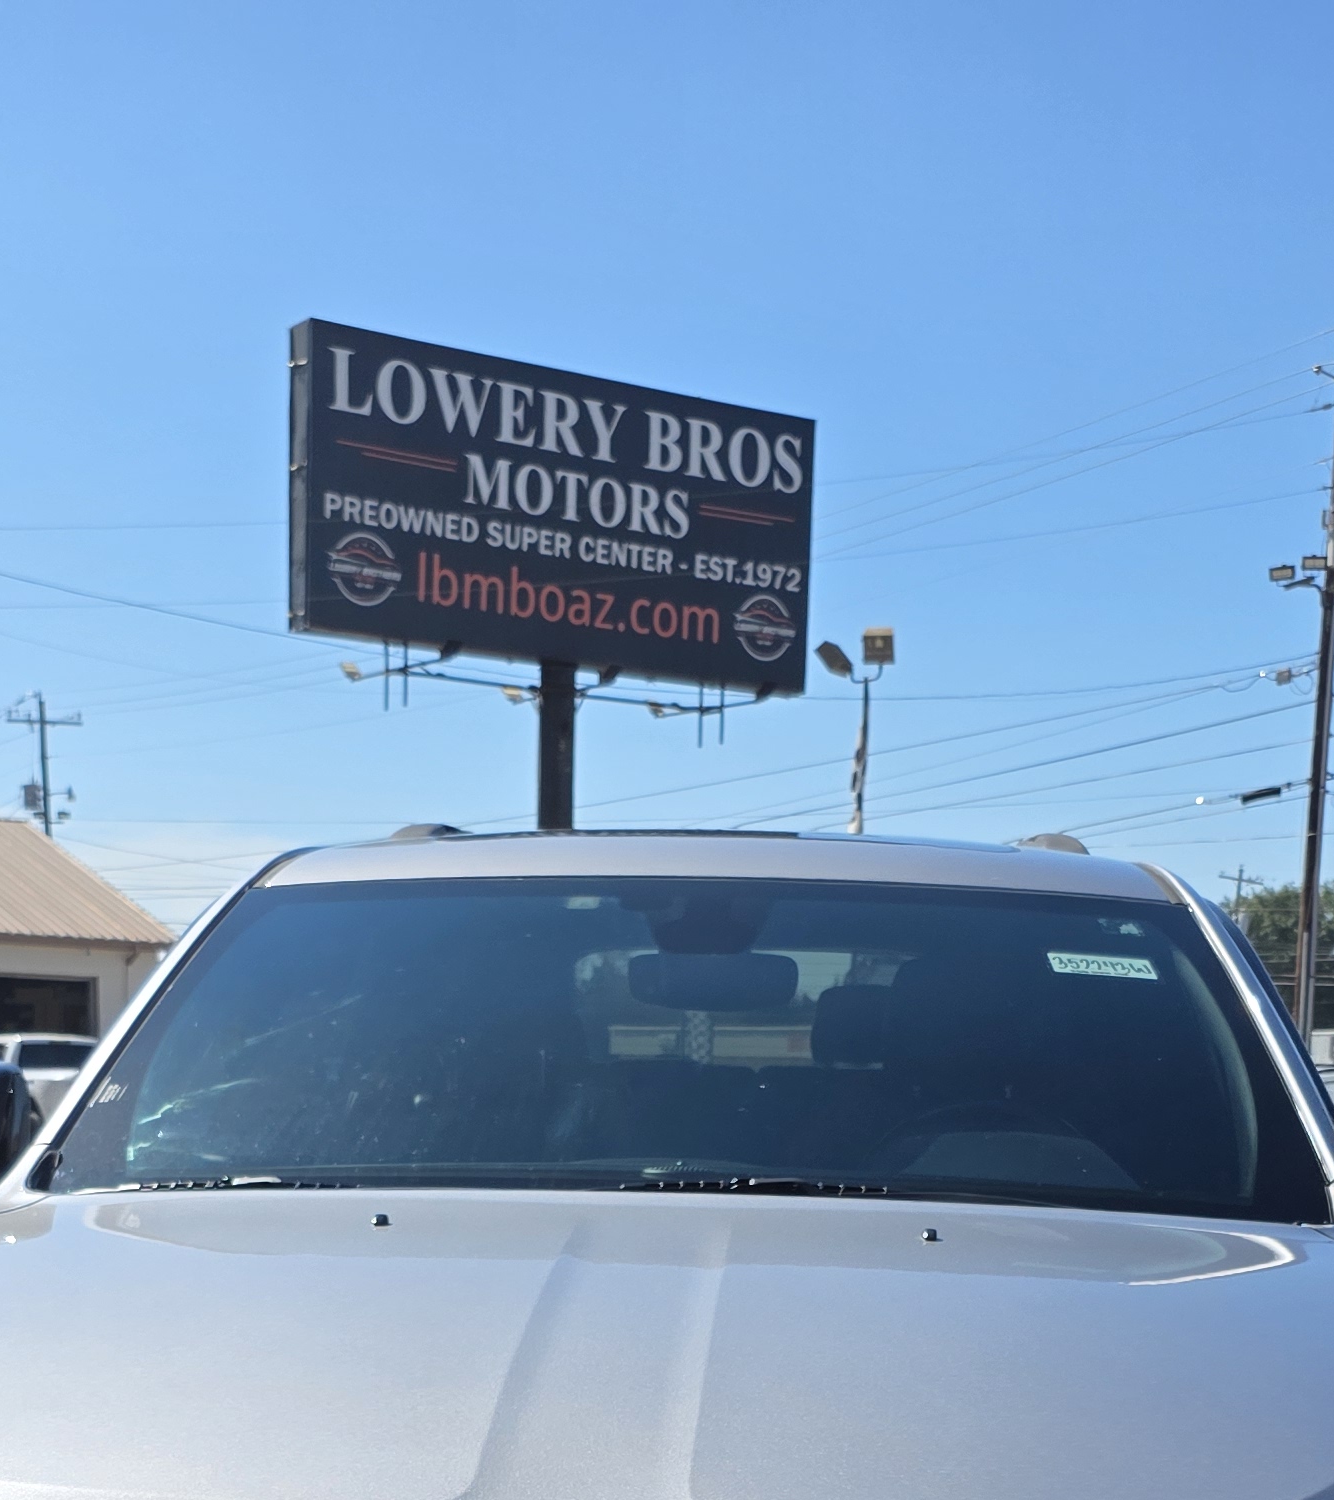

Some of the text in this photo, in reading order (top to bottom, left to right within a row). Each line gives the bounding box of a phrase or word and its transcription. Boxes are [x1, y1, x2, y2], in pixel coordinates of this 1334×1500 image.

[327, 346, 804, 494] LOWERY BROS
[323, 492, 480, 543] PREOWNED
[486, 519, 572, 559] SUPER
[578, 536, 674, 575] CENTER
[693, 553, 802, 593] EST.1972
[463, 453, 690, 540] MOTORS
[418, 550, 720, 645] lbmboaz.com
